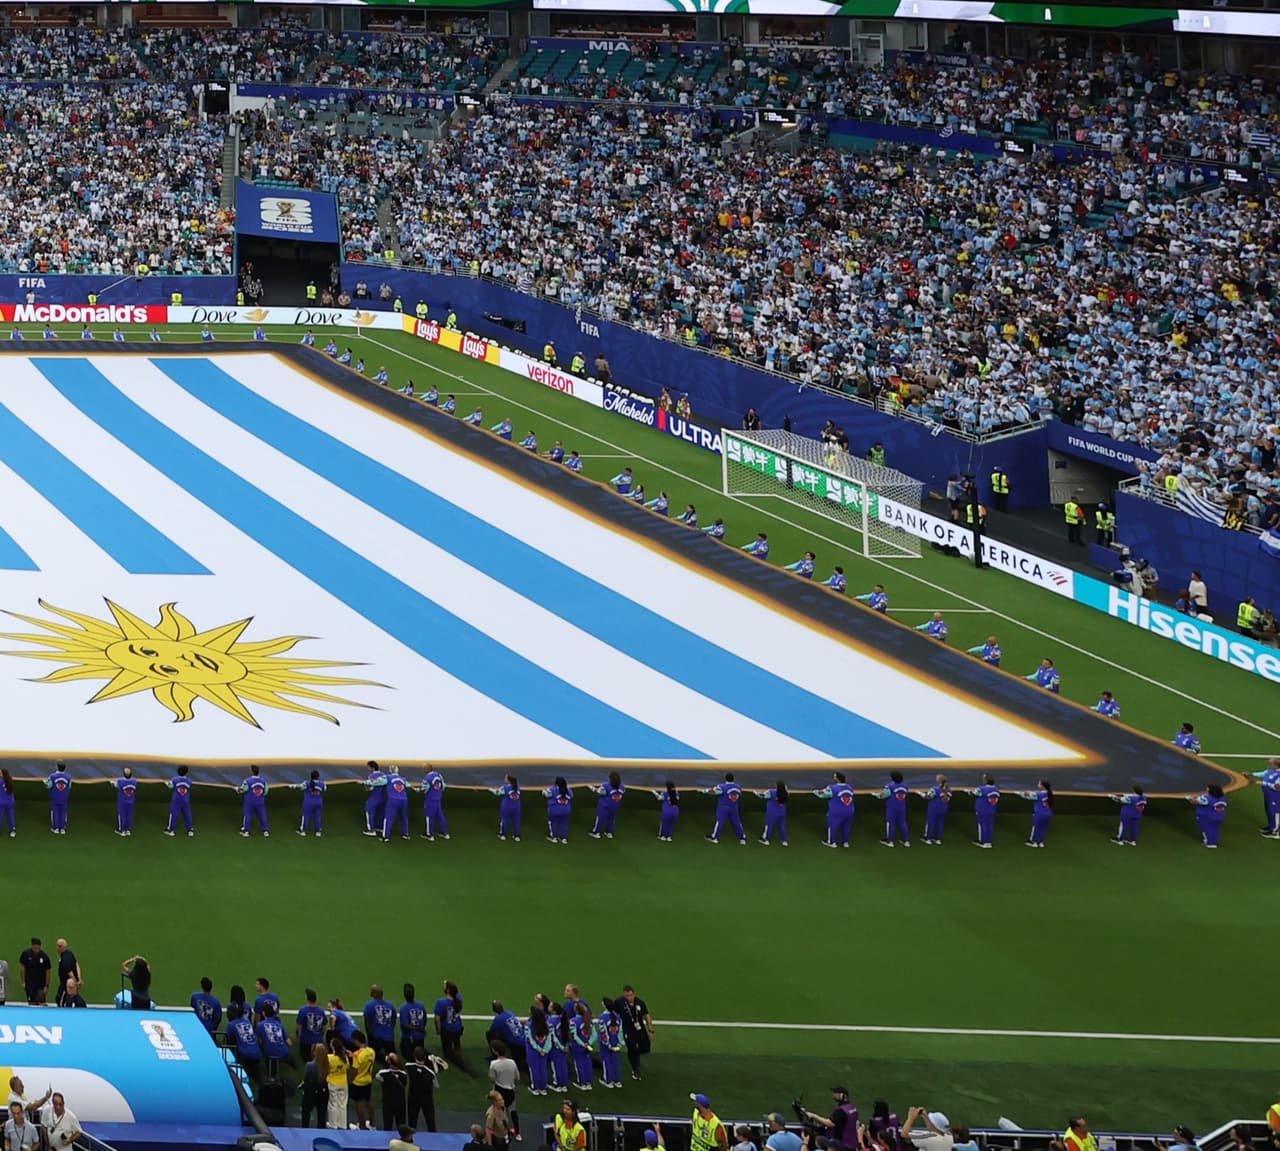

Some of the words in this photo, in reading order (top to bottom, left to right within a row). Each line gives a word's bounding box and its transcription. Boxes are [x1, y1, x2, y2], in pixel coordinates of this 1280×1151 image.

[19, 278, 46, 288] FIFA
[13, 304, 148, 323] McDonald's
[191, 307, 238, 325] Dove
[294, 308, 342, 326] Dove
[415, 319, 440, 341] Lay's
[580, 321, 599, 338] FIFA
[462, 335, 486, 359] Lay's
[527, 362, 574, 395] verizon
[604, 390, 655, 426] Michelob
[669, 416, 724, 454] ULTRA
[1068, 436, 1085, 448] FIFA
[1086, 440, 1116, 459] WORLD
[1117, 452, 1134, 464] CUP
[885, 503, 928, 533] BANK
[934, 524, 954, 545] OF
[1108, 585, 1280, 684] Hisense
